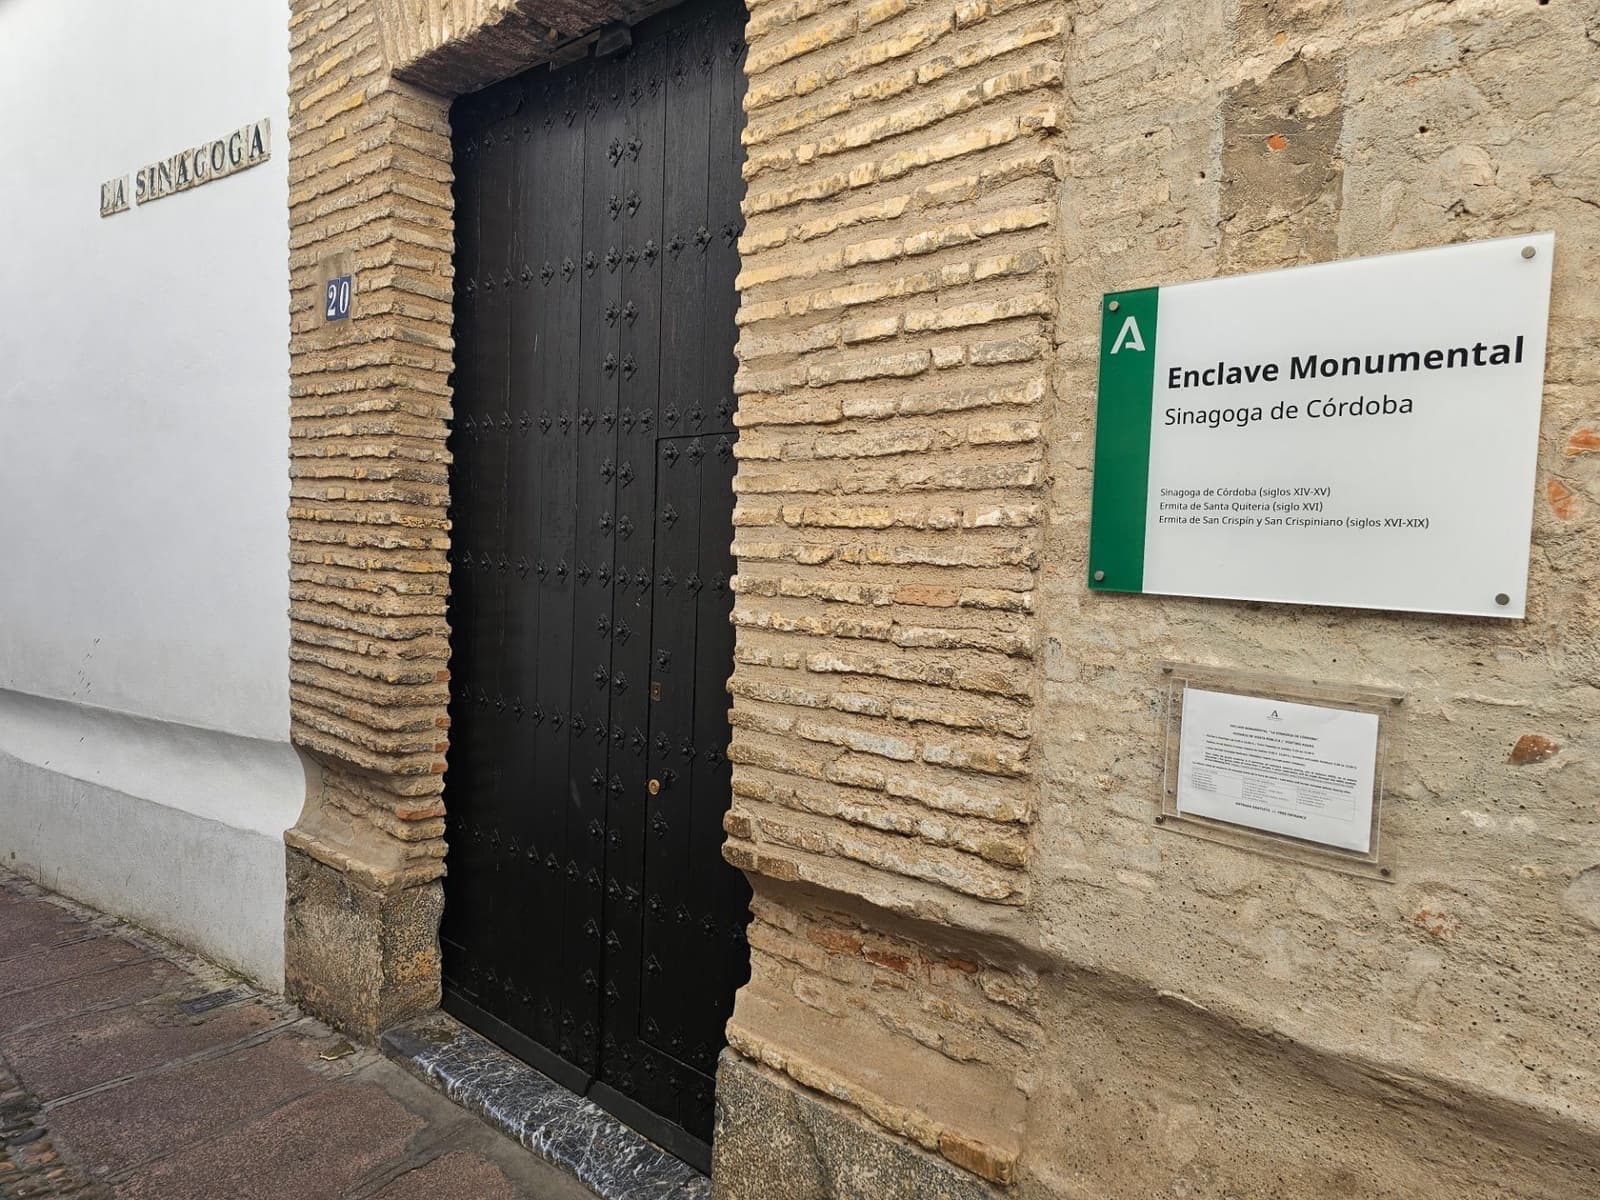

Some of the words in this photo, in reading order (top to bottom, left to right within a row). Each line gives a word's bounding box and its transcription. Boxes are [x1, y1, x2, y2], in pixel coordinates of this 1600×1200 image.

[100, 179, 127, 210] LA
[135, 123, 265, 200] SINAGOGA
[327, 281, 349, 317] 20
[1168, 362, 1279, 389] Enclave
[1290, 335, 1524, 380] Monumental
[1164, 408, 1262, 429] Sinagoga
[1270, 401, 1298, 420] de
[1306, 394, 1413, 418] Córdoba
[1159, 502, 1188, 511] Ermita
[1190, 502, 1201, 511] de
[1203, 502, 1229, 511] Santa
[1231, 502, 1270, 512] Quiteria
[1272, 501, 1300, 513] (siglo
[1302, 501, 1323, 512] XVI)
[1160, 488, 1200, 499] Sinagoga
[1203, 488, 1214, 497] de
[1216, 487, 1257, 497] Córdoba
[1259, 487, 1291, 498] (siglos
[1293, 486, 1331, 498] XIV-XV)
[1159, 515, 1187, 524] Ermita
[1189, 516, 1201, 524] de
[1203, 516, 1219, 525] San
[1221, 516, 1254, 527] Crispín
[1256, 518, 1263, 527] y
[1264, 517, 1283, 526] San
[1285, 517, 1344, 528] Crispiniano
[1346, 517, 1381, 529] (siglos
[1383, 517, 1429, 529] XVI-XIX)
